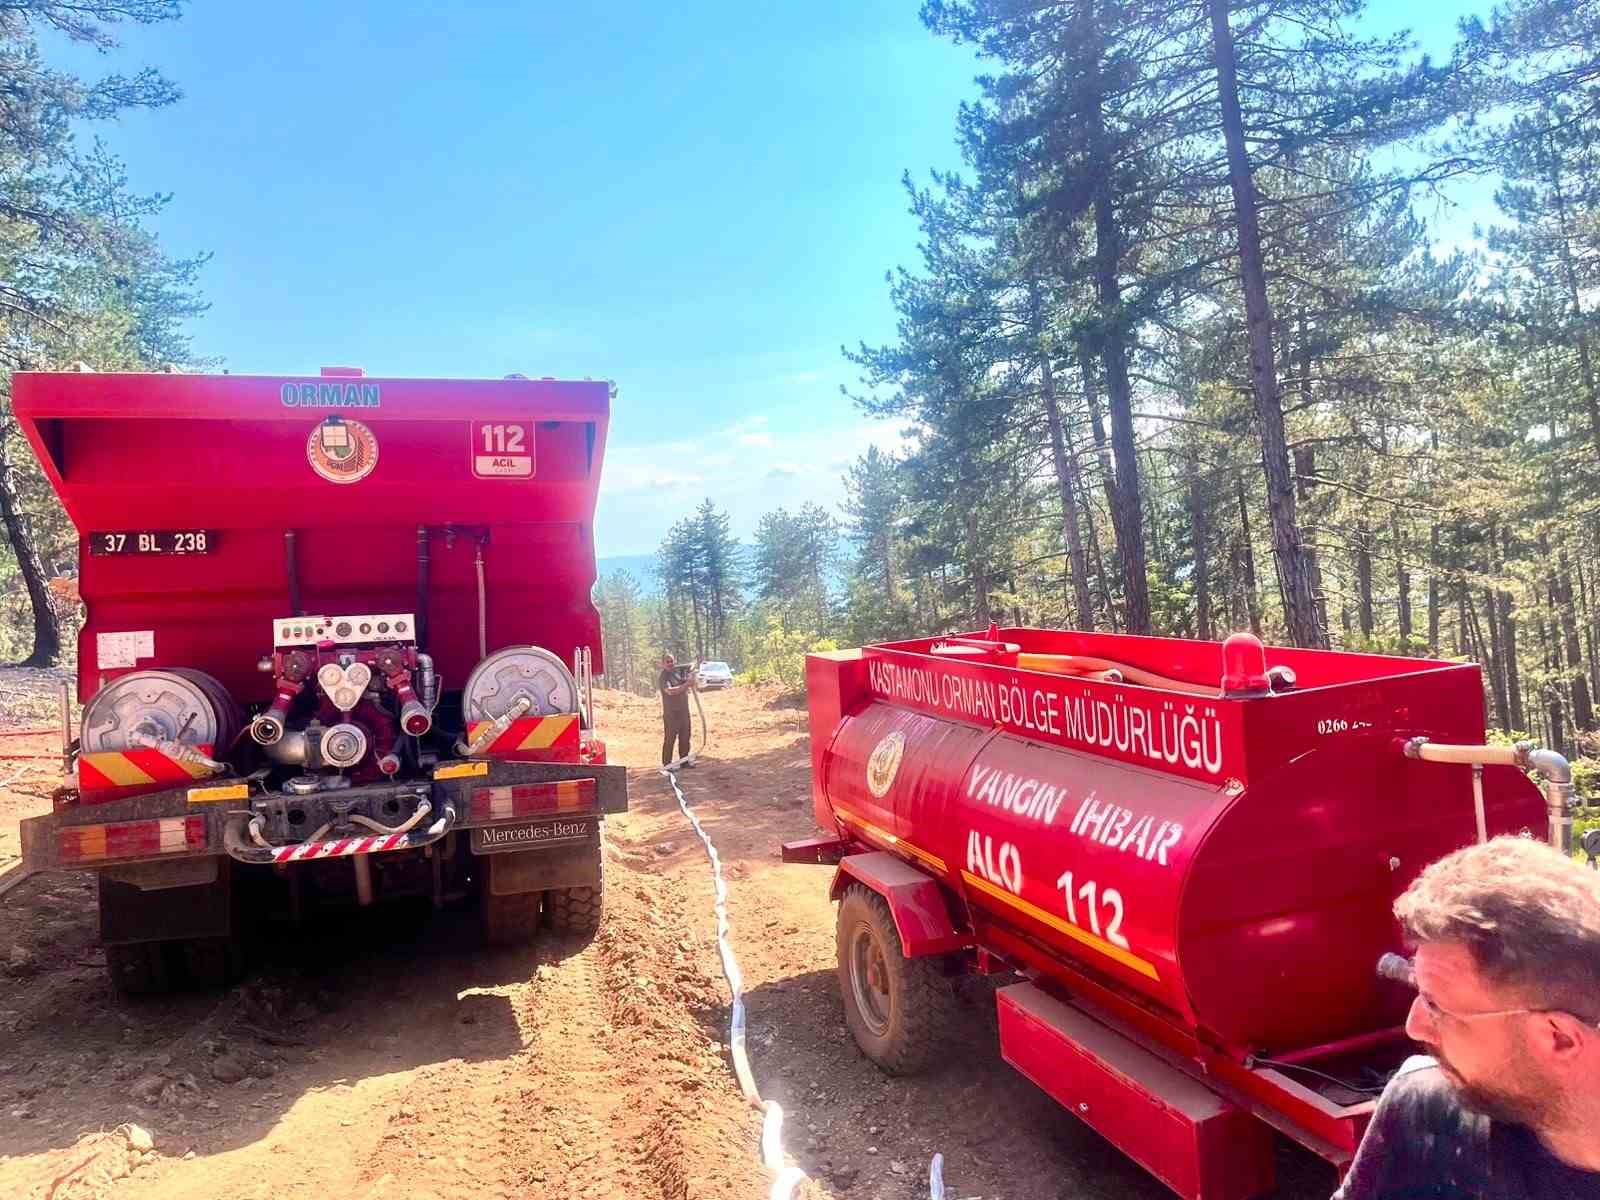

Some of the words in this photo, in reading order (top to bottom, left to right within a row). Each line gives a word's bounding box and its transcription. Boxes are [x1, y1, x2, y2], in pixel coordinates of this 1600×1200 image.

[281, 383, 380, 408] ORMAN
[481, 424, 525, 452] 112
[105, 534, 126, 552] 37
[139, 534, 162, 551] BL
[174, 533, 206, 551] 238
[868, 660, 940, 707] KASTAMONU
[942, 674, 997, 721] ORMAN
[998, 677, 1061, 736] BÖLGE
[1065, 689, 1222, 774] MÜDÜRLÜĞÜ
[966, 764, 1067, 824] YANGIN
[1070, 791, 1183, 866] İHBAR
[482, 822, 588, 844] Mercedes-Benz
[966, 829, 1023, 895] ALO
[1057, 871, 1130, 951] 112
